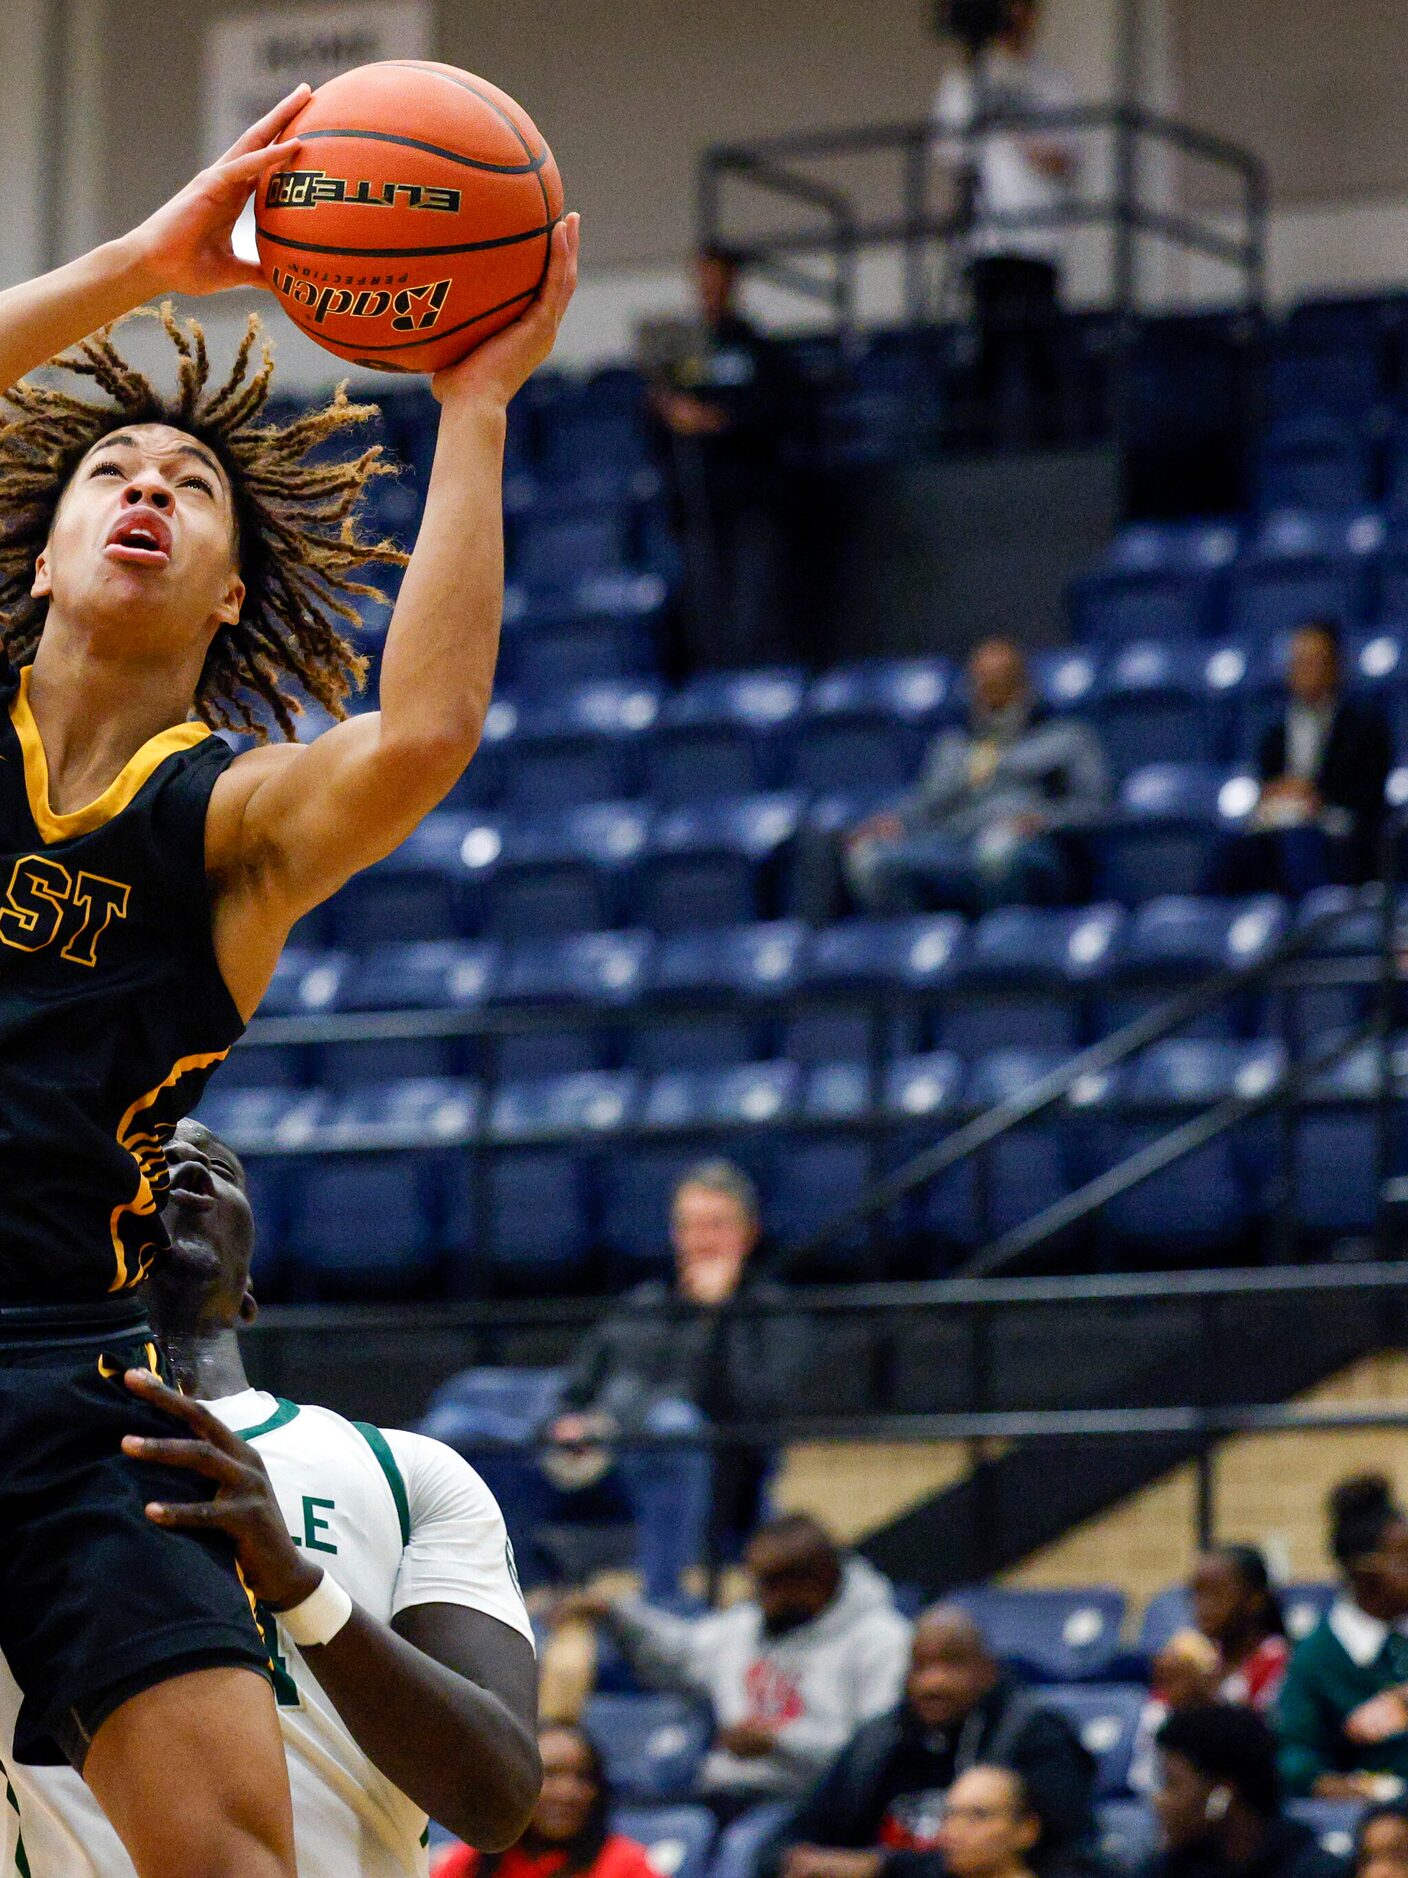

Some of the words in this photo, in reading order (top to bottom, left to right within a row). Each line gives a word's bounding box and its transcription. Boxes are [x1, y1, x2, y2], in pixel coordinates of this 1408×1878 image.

[267, 174, 314, 206] PRO
[312, 177, 462, 214] ELITE
[290, 263, 409, 285] PERFECTION
[272, 266, 453, 332] Baden
